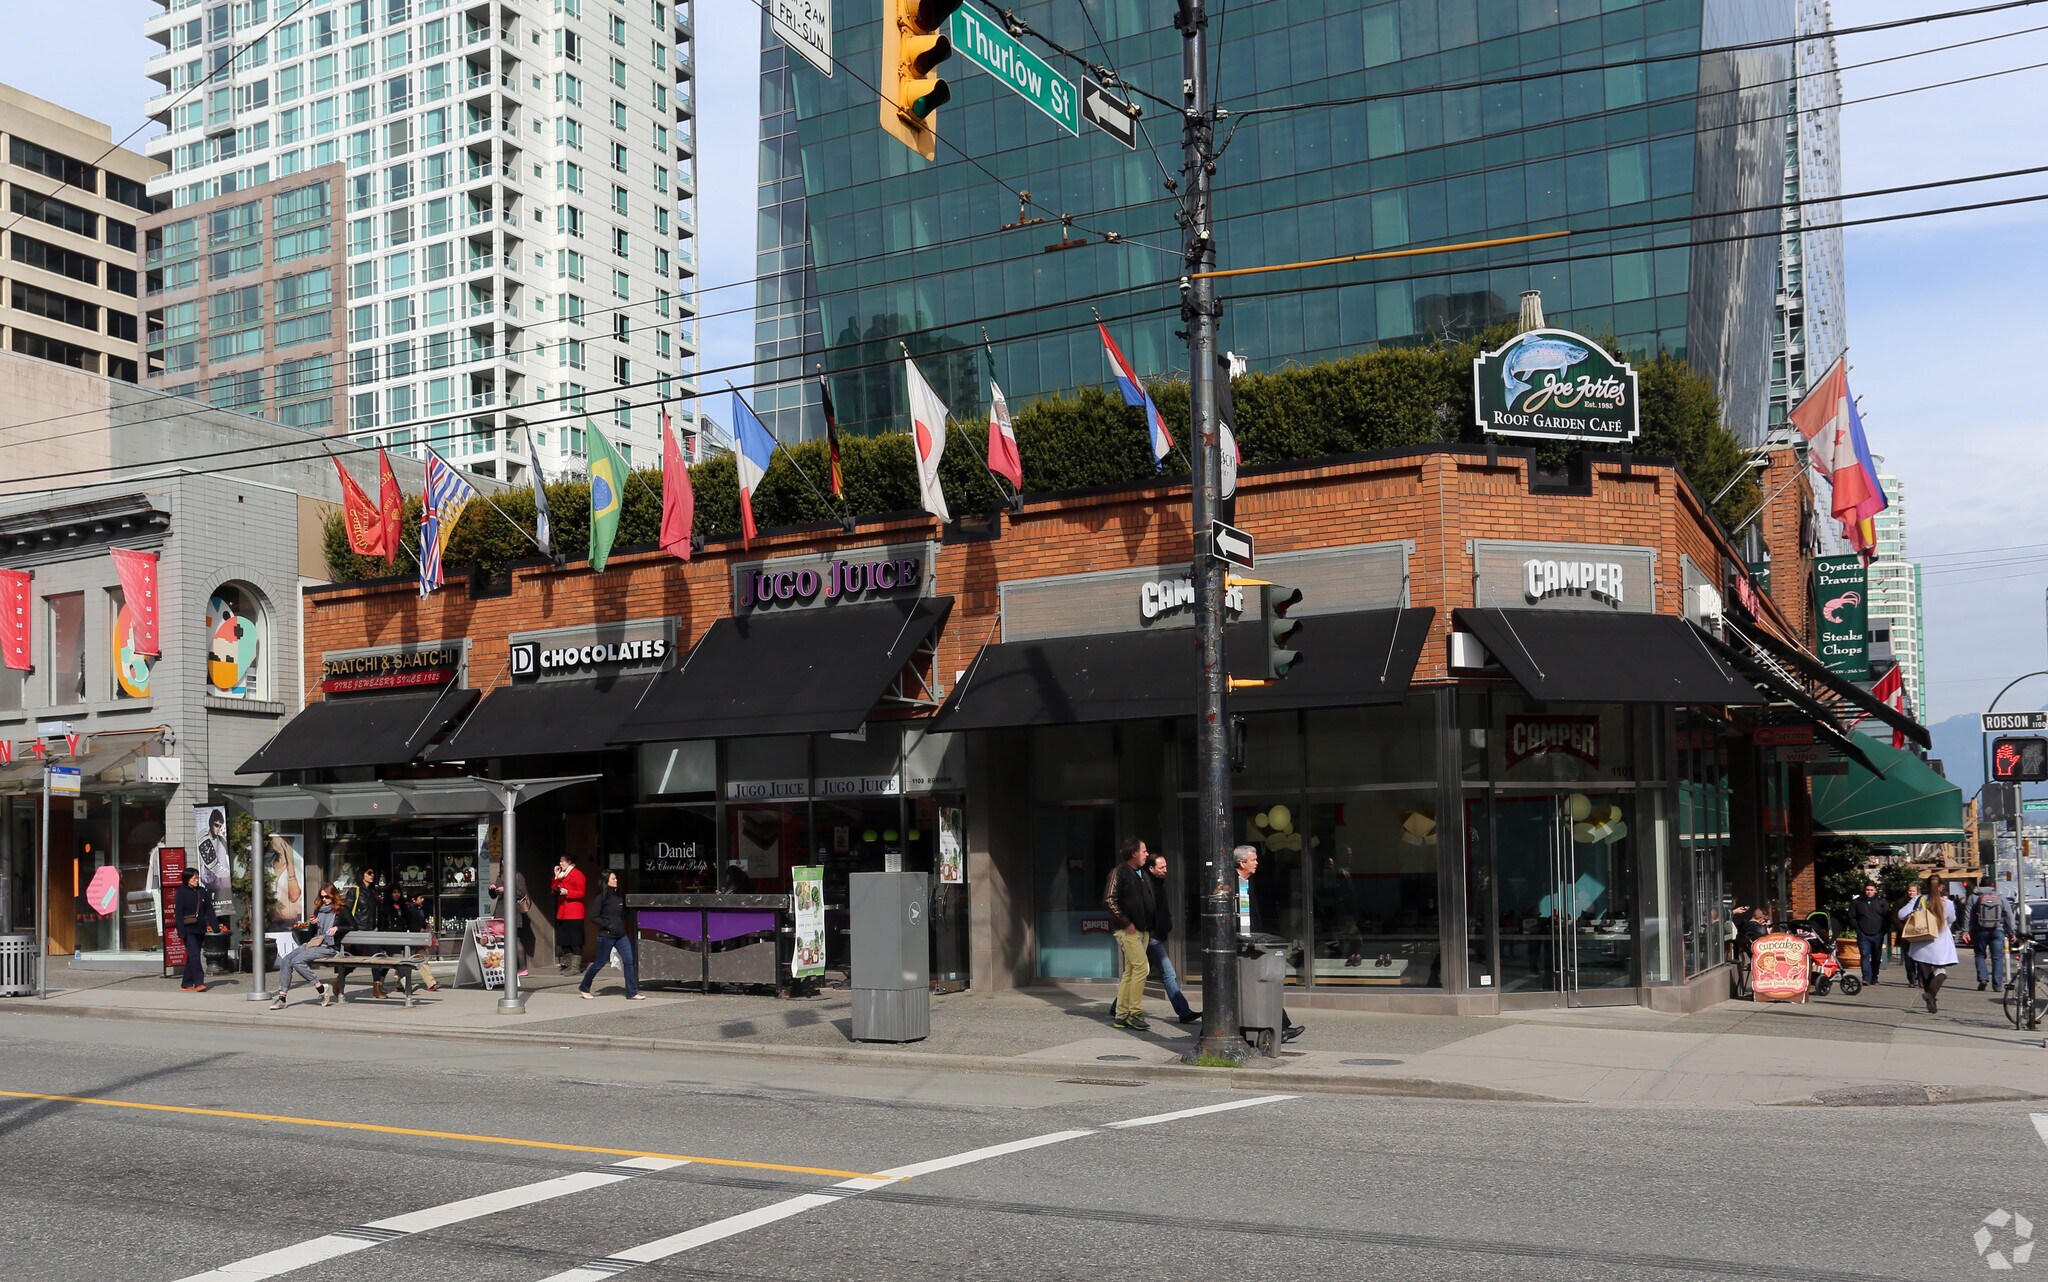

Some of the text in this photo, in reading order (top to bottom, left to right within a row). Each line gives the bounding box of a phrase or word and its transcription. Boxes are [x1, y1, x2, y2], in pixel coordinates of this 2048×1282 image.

[780, 3, 824, 51] FRI-SUN
[961, 10, 1071, 121] Thurlow St
[1522, 373, 1626, 414] Joe Fortes
[1584, 401, 1598, 409] Est.
[1494, 410, 1623, 433] ROOF GARDEN CAFÉ
[740, 558, 918, 607] JUGO JUICE
[1525, 559, 1624, 603] CAMPER
[1820, 575, 1864, 586] Prawns
[1141, 573, 1244, 618] CAMR
[1822, 629, 1863, 642] Steaks
[512, 638, 665, 674] D CHOCOLATES
[1823, 644, 1863, 656] Chops
[323, 649, 454, 676] SAATCHI & SAATCHI
[333, 680, 353, 690] FINE
[354, 676, 396, 690] JEWELERY
[397, 673, 422, 684] SINCE
[1986, 715, 2029, 729] ROBSON
[1513, 722, 1595, 757] CAMPER
[1786, 753, 1818, 761] WIND
[1612, 767, 1633, 777] 1101
[735, 781, 805, 799] JUGO JUICE
[821, 777, 896, 795] JUGO JUICE
[658, 842, 697, 858] Daniel
[645, 859, 656, 871] Le
[657, 859, 686, 871] Chocolat
[1082, 920, 1109, 931] CAMPER
[1758, 938, 1803, 951] cupcakes
